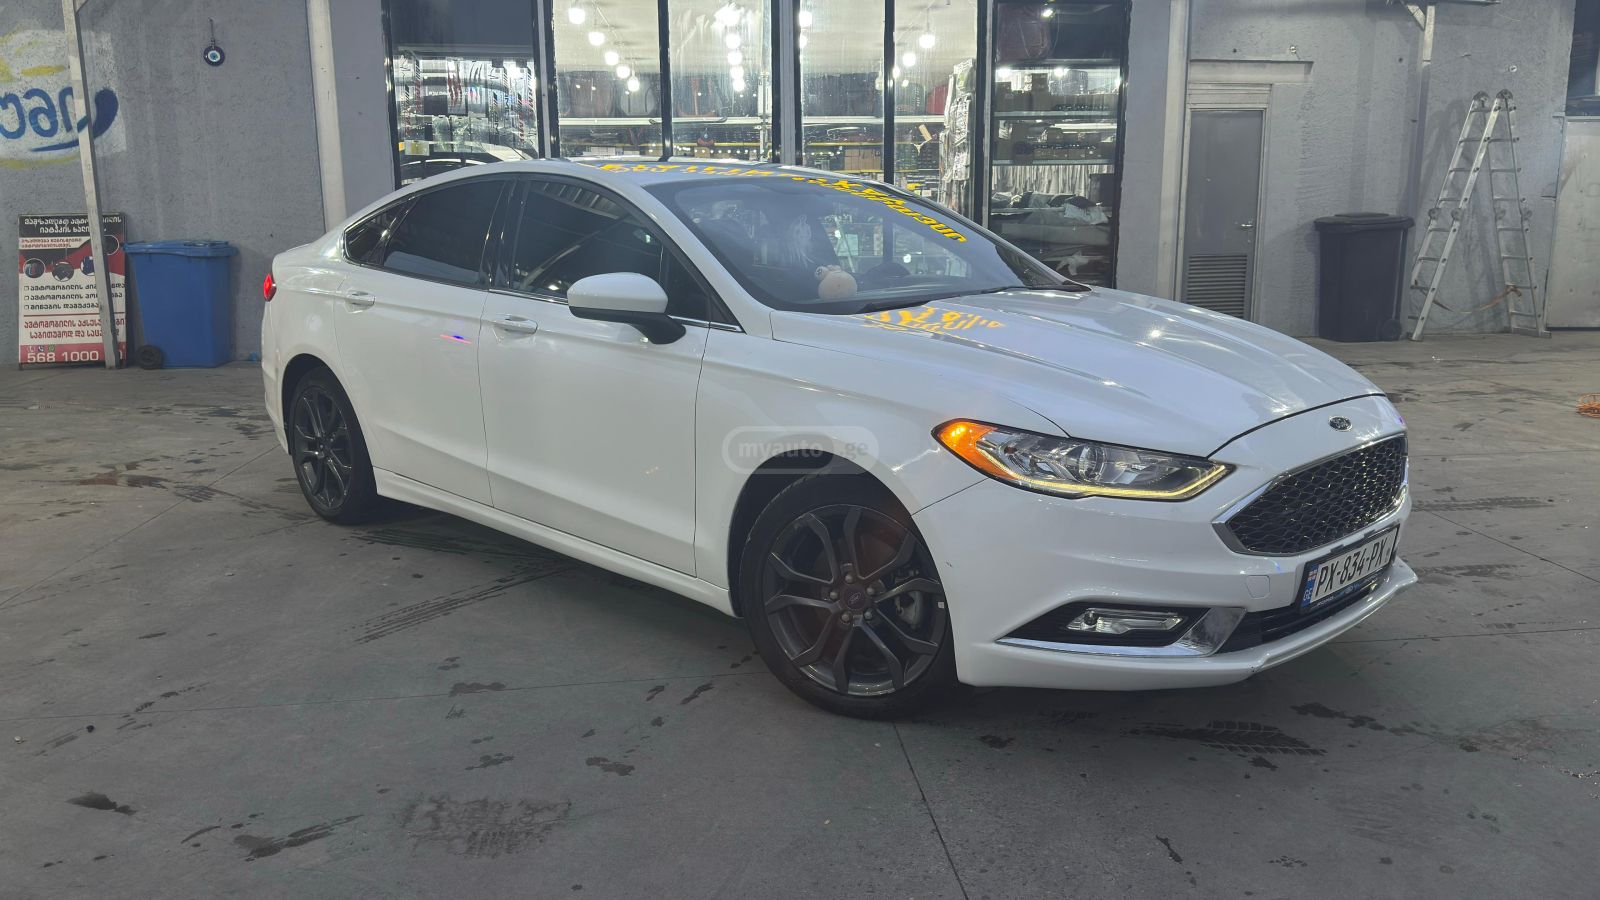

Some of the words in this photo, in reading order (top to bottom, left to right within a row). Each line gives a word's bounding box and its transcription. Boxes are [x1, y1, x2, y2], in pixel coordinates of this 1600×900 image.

[30, 293, 83, 301] ავტომობილის
[24, 319, 76, 328] ავტომობილის
[30, 330, 73, 339] საბითუმოდ
[75, 329, 85, 337] და
[27, 352, 56, 363] 568
[62, 350, 99, 362] 1000
[1314, 537, 1387, 597] PX-834-PX
